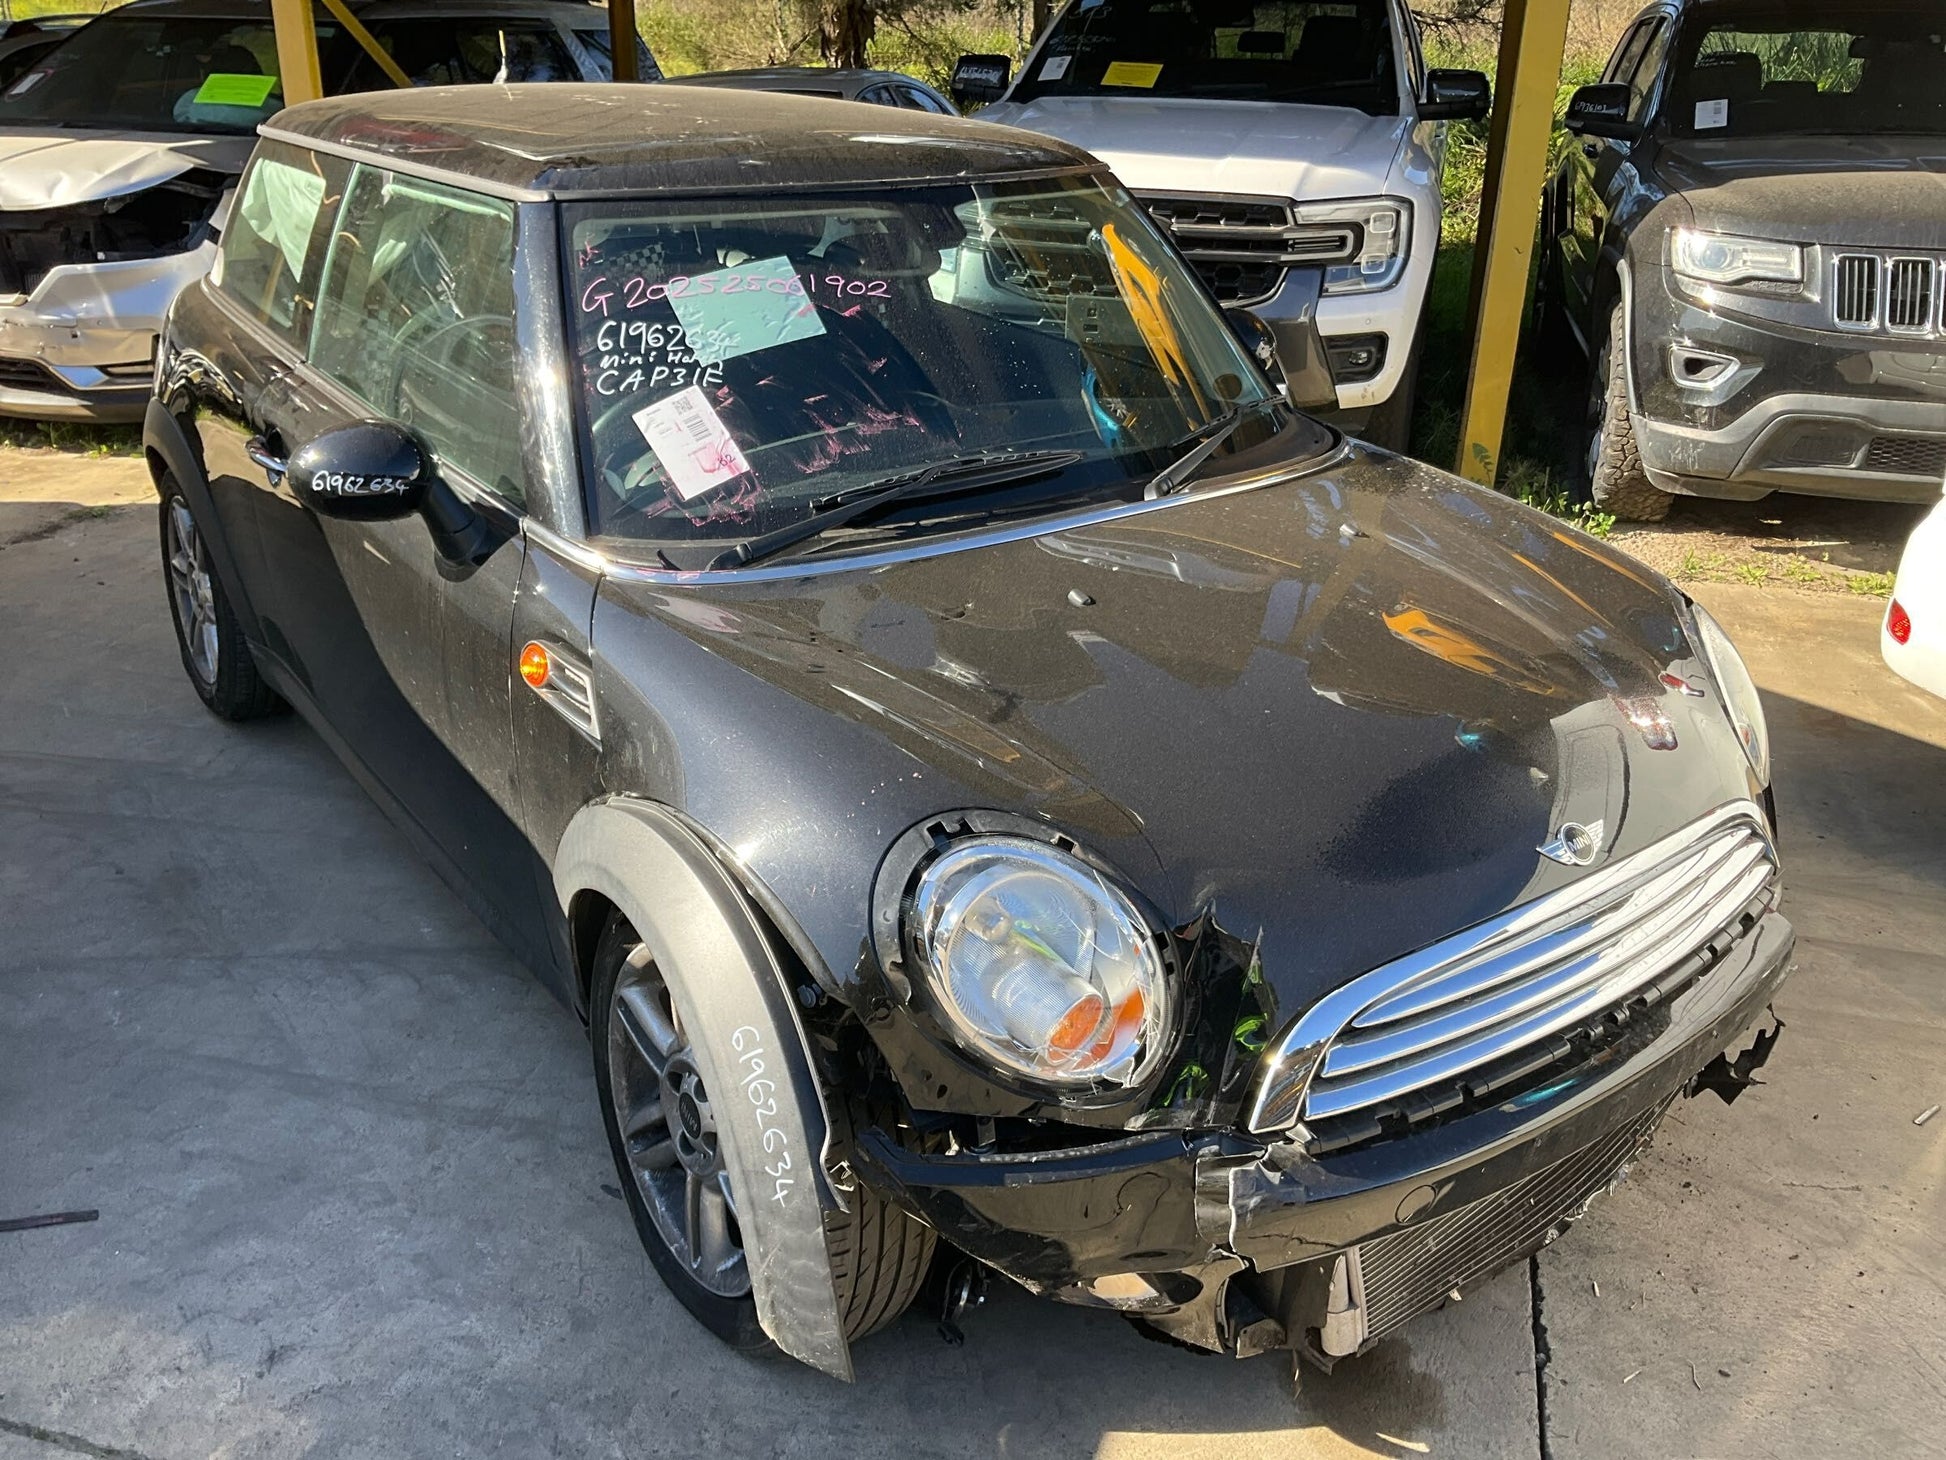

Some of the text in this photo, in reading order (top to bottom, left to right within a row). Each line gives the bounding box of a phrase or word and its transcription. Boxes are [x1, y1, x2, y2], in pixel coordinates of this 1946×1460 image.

[582, 277, 614, 316] G
[312, 470, 409, 496] 61962634
[1567, 834, 1591, 852] MINI
[731, 1025, 795, 1208] 61962634
